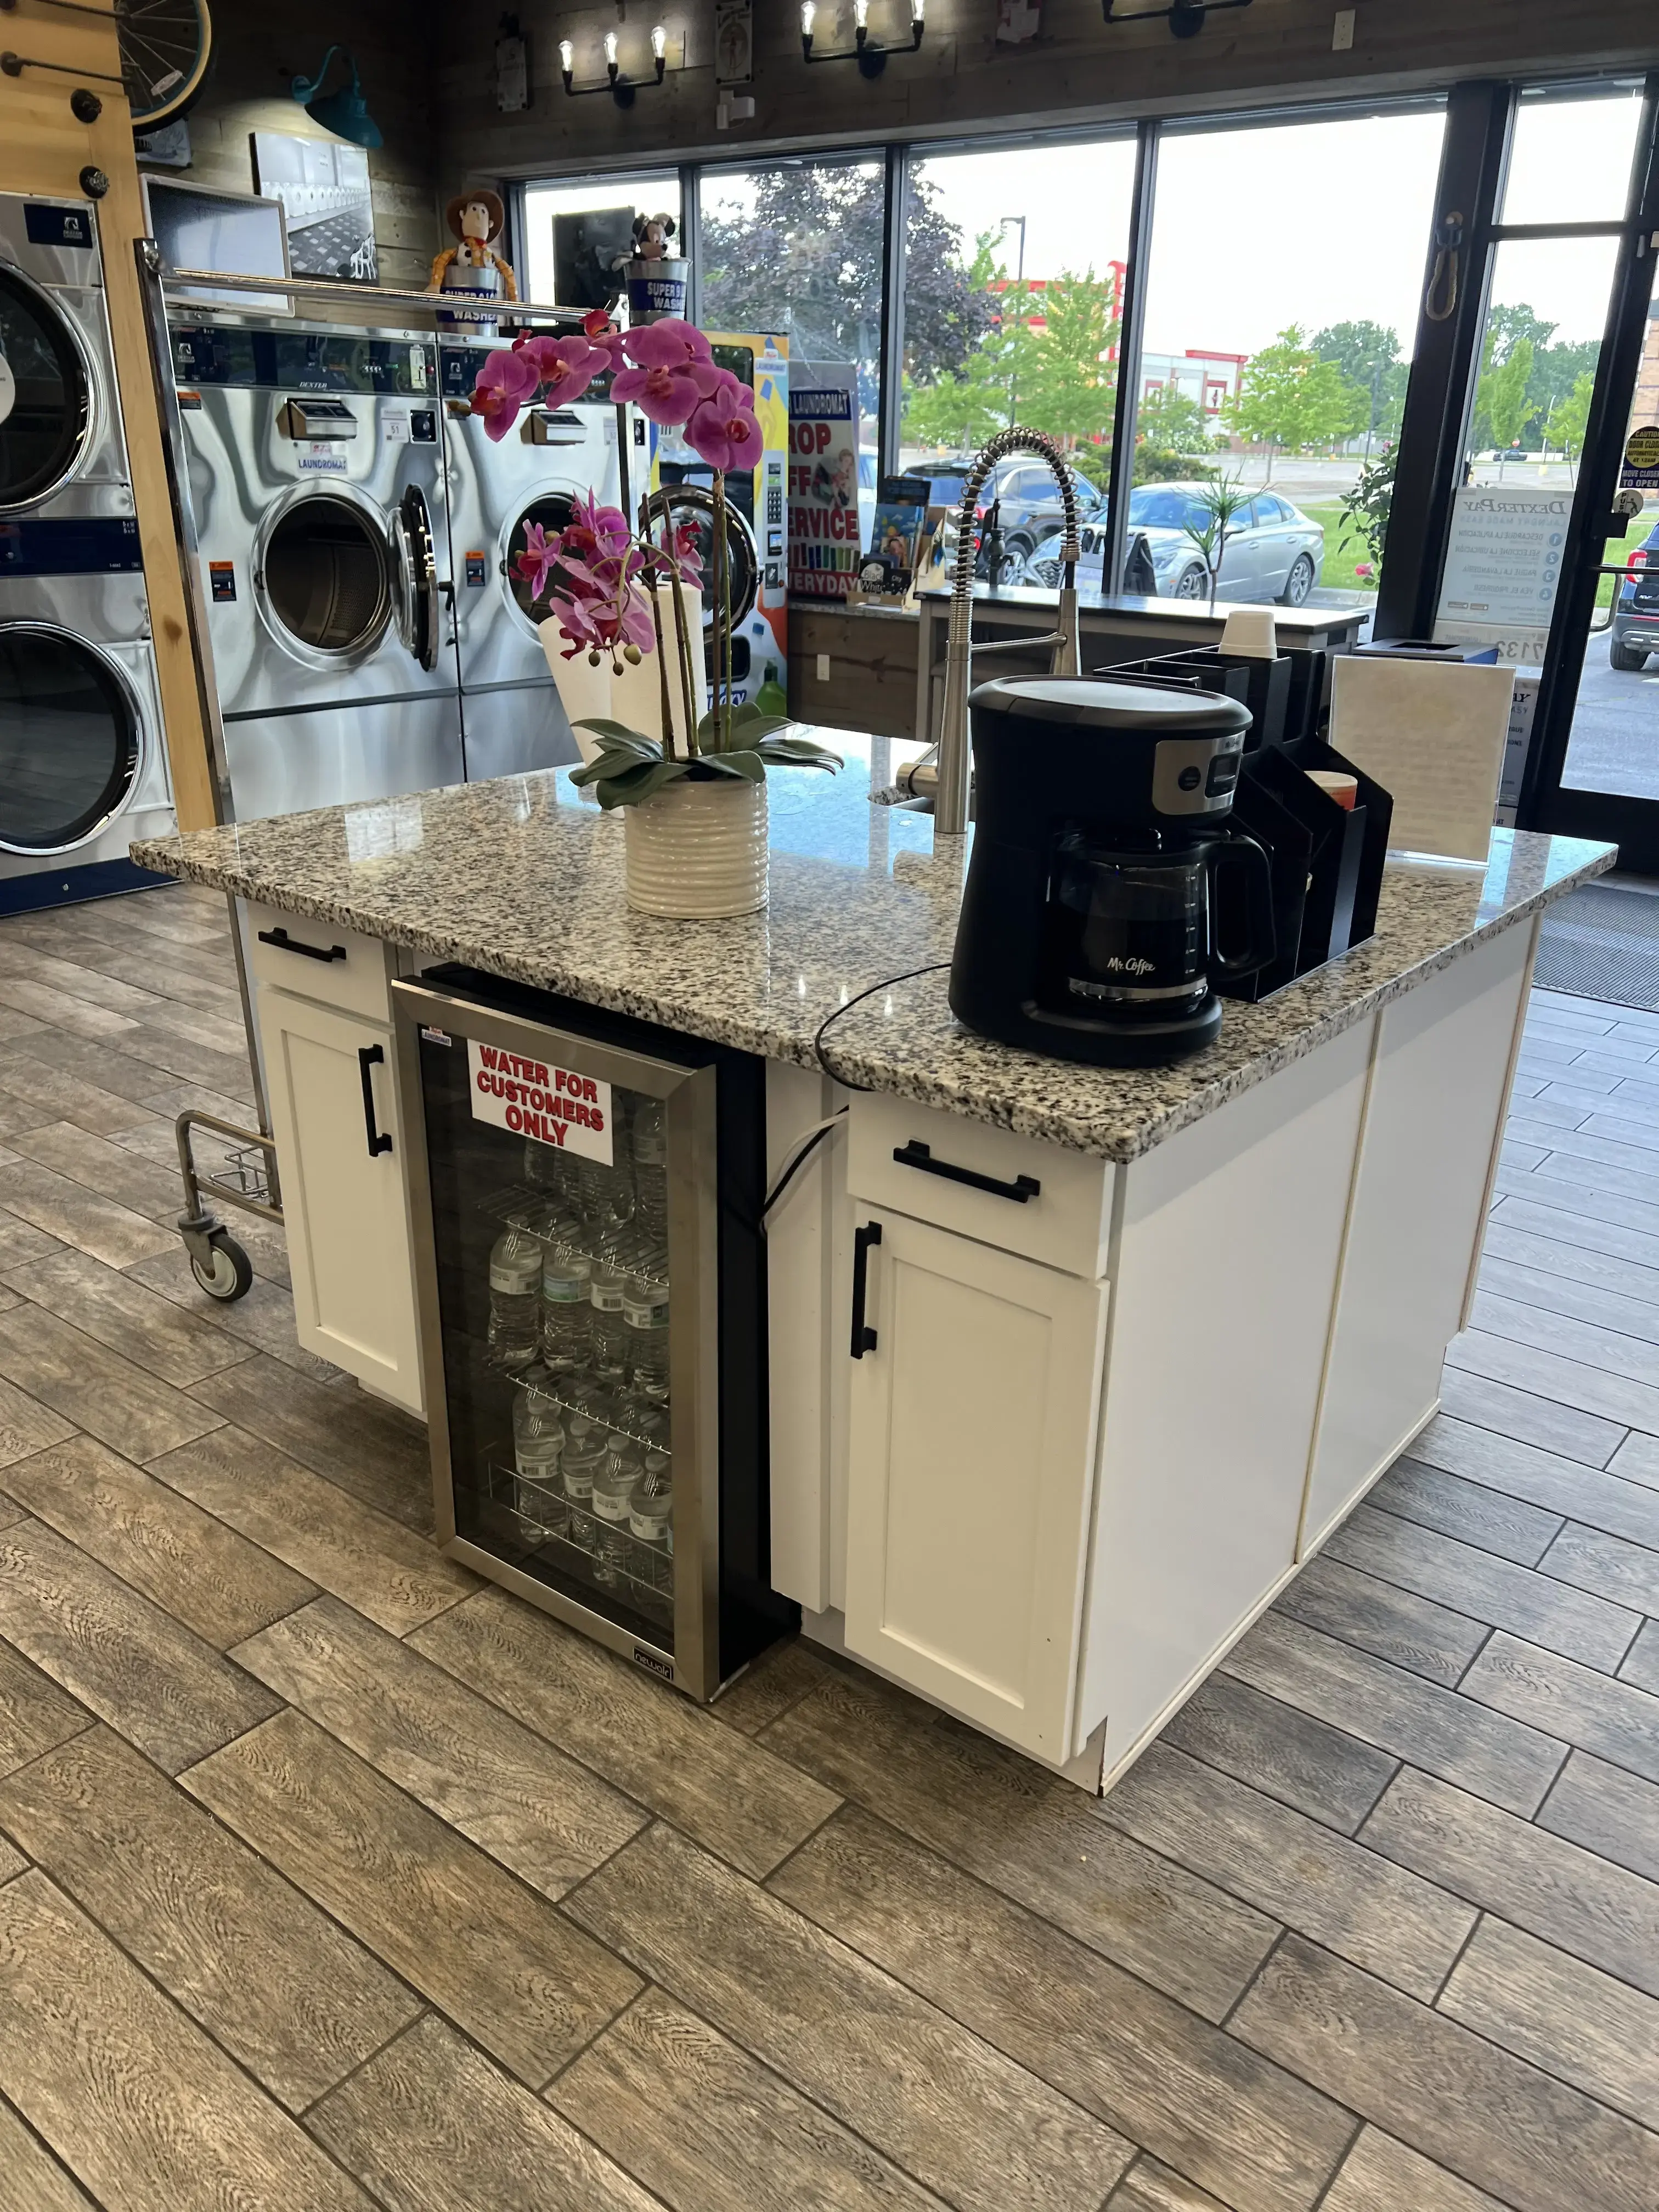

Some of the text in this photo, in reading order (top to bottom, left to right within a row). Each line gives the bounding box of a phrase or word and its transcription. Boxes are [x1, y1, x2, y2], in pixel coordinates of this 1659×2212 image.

[648, 282, 675, 296] SUPER
[793, 394, 848, 415] LAUNDROMAT
[1623, 479, 1658, 488] TO OPEN
[1107, 957, 1156, 975] Mr. Coffee
[479, 1045, 598, 1103] WATER FOR
[477, 1070, 604, 1131] CUSTOMERS
[506, 1104, 569, 1147] ONLY
